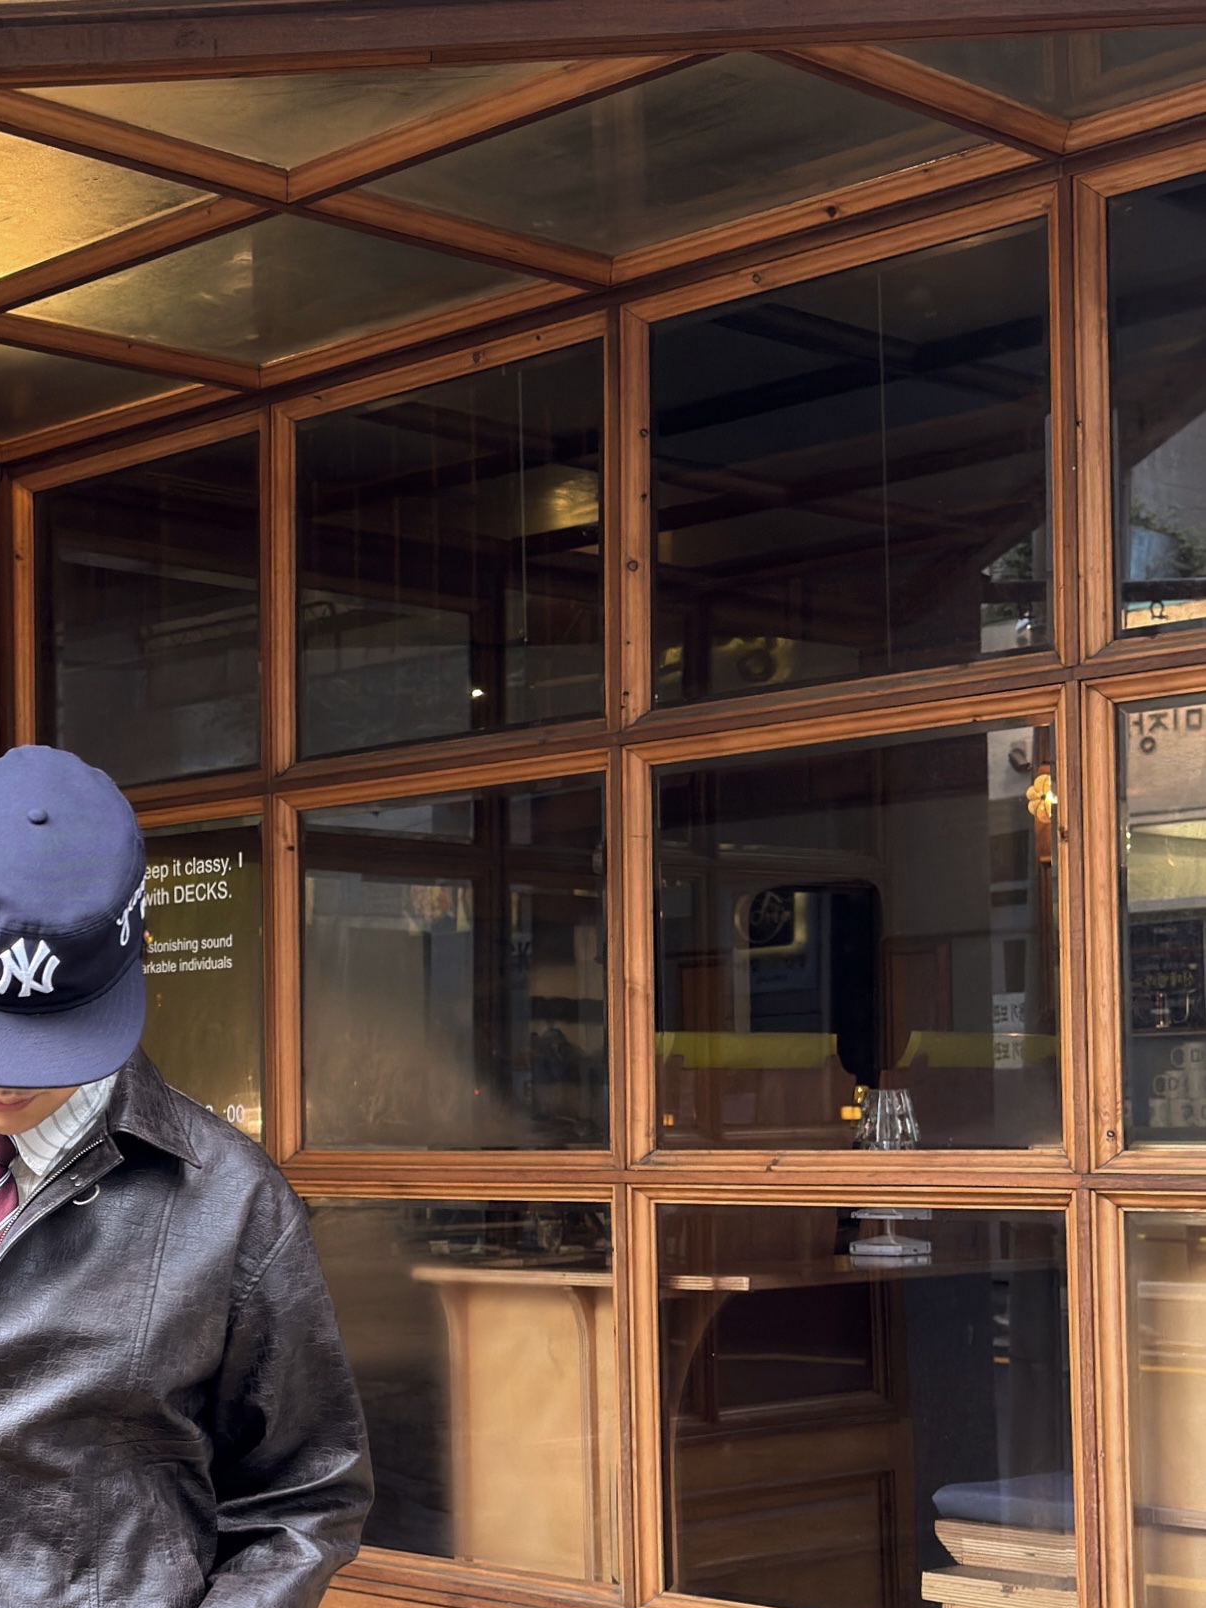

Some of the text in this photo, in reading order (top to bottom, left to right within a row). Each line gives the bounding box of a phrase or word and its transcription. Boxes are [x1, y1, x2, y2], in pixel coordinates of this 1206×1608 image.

[145, 864, 168, 882] eep
[173, 859, 181, 876] it
[185, 857, 232, 876] classy.
[145, 881, 232, 906] with DECKS.
[147, 933, 233, 953] stonishing sound
[142, 956, 233, 974] arkable individuals
